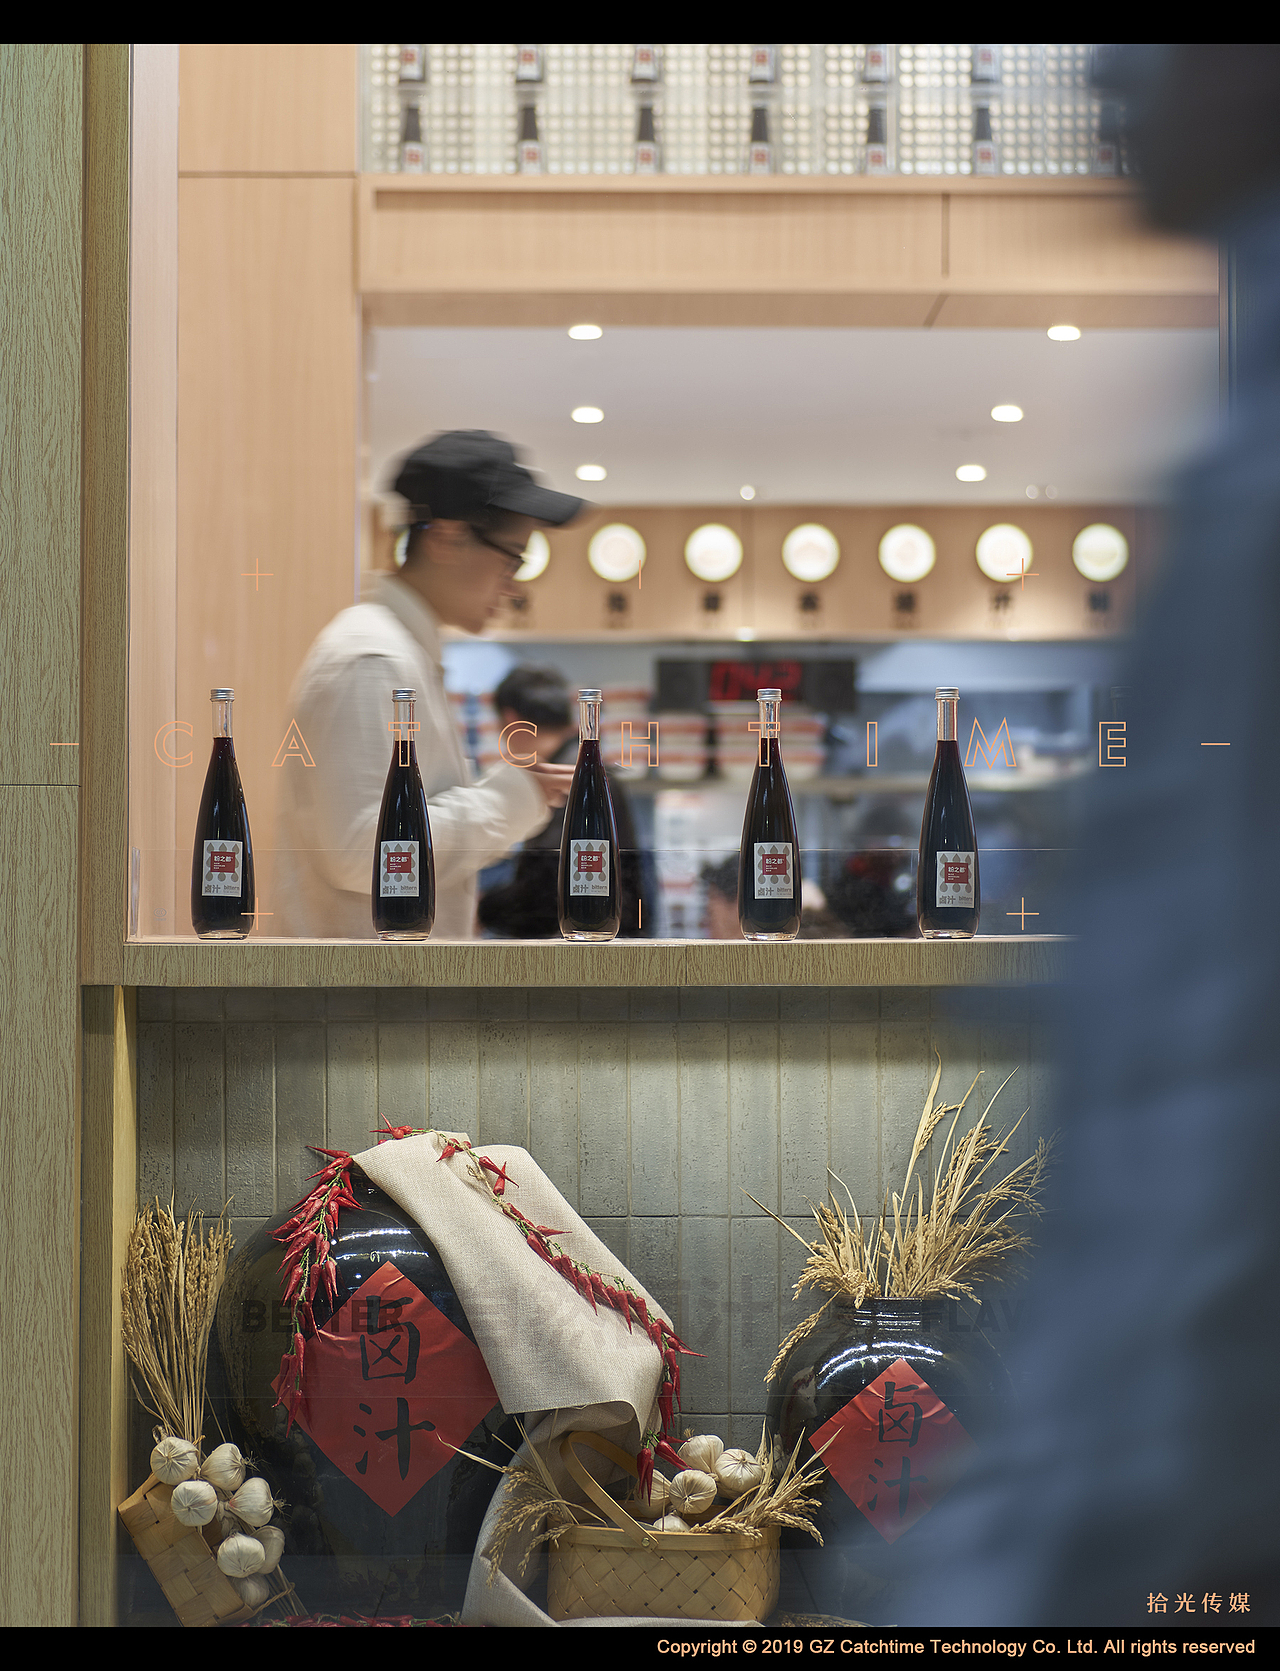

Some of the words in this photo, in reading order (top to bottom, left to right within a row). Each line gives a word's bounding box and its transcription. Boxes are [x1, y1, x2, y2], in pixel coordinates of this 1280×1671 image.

[242, 1300, 404, 1333] BETER
[353, 1295, 436, 1481] 卤汁
[866, 1381, 929, 1519] 卤汁
